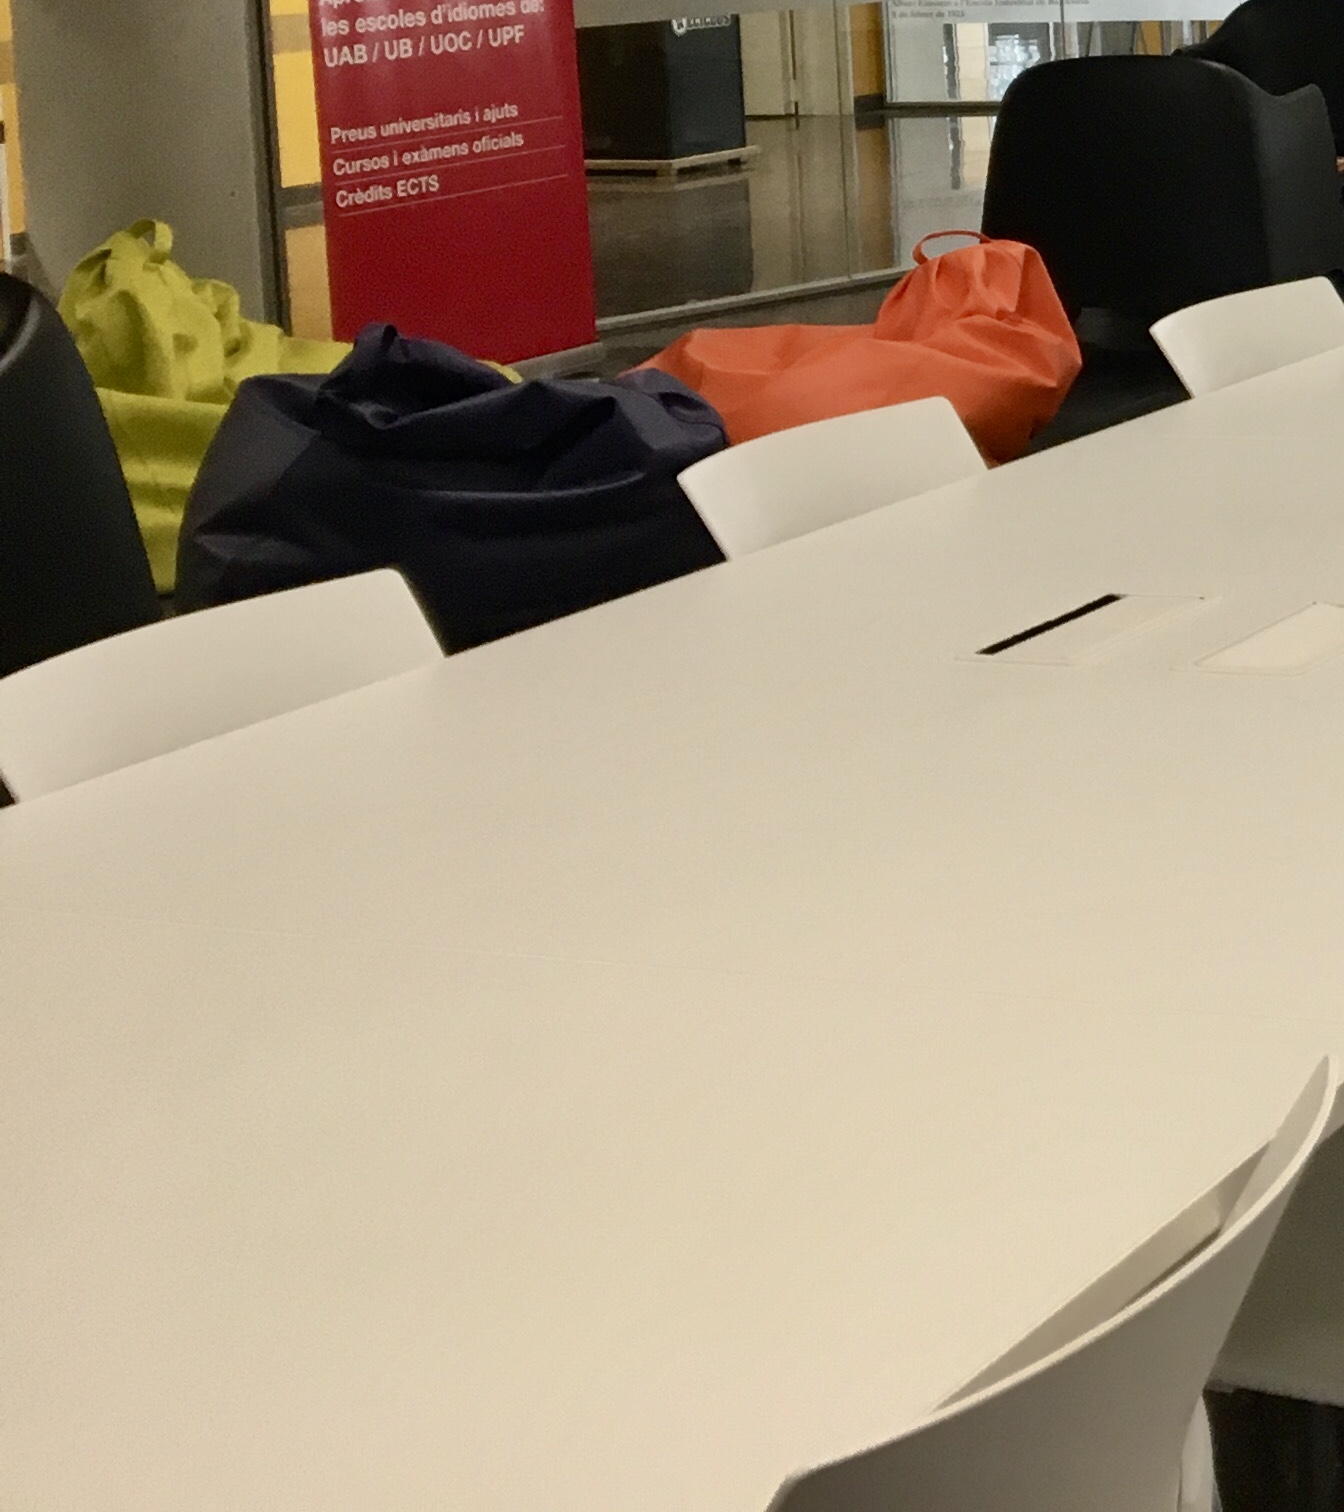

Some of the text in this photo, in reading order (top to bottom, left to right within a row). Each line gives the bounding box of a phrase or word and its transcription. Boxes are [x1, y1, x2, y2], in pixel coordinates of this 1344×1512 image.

[321, 15, 349, 37] les
[355, 8, 426, 33] escoles
[430, 1, 516, 26] d'idiomes
[324, 44, 368, 68] UAB
[384, 39, 413, 61] UB
[430, 30, 473, 55] UOC
[488, 25, 525, 48] UPF
[330, 126, 378, 145] Preus
[380, 111, 471, 139] universitaris
[483, 102, 519, 122] ajuts
[333, 156, 389, 177] Cursos
[402, 140, 469, 165] exàmens
[473, 132, 524, 153] oficials
[335, 175, 440, 209] Crèdits ECTS
